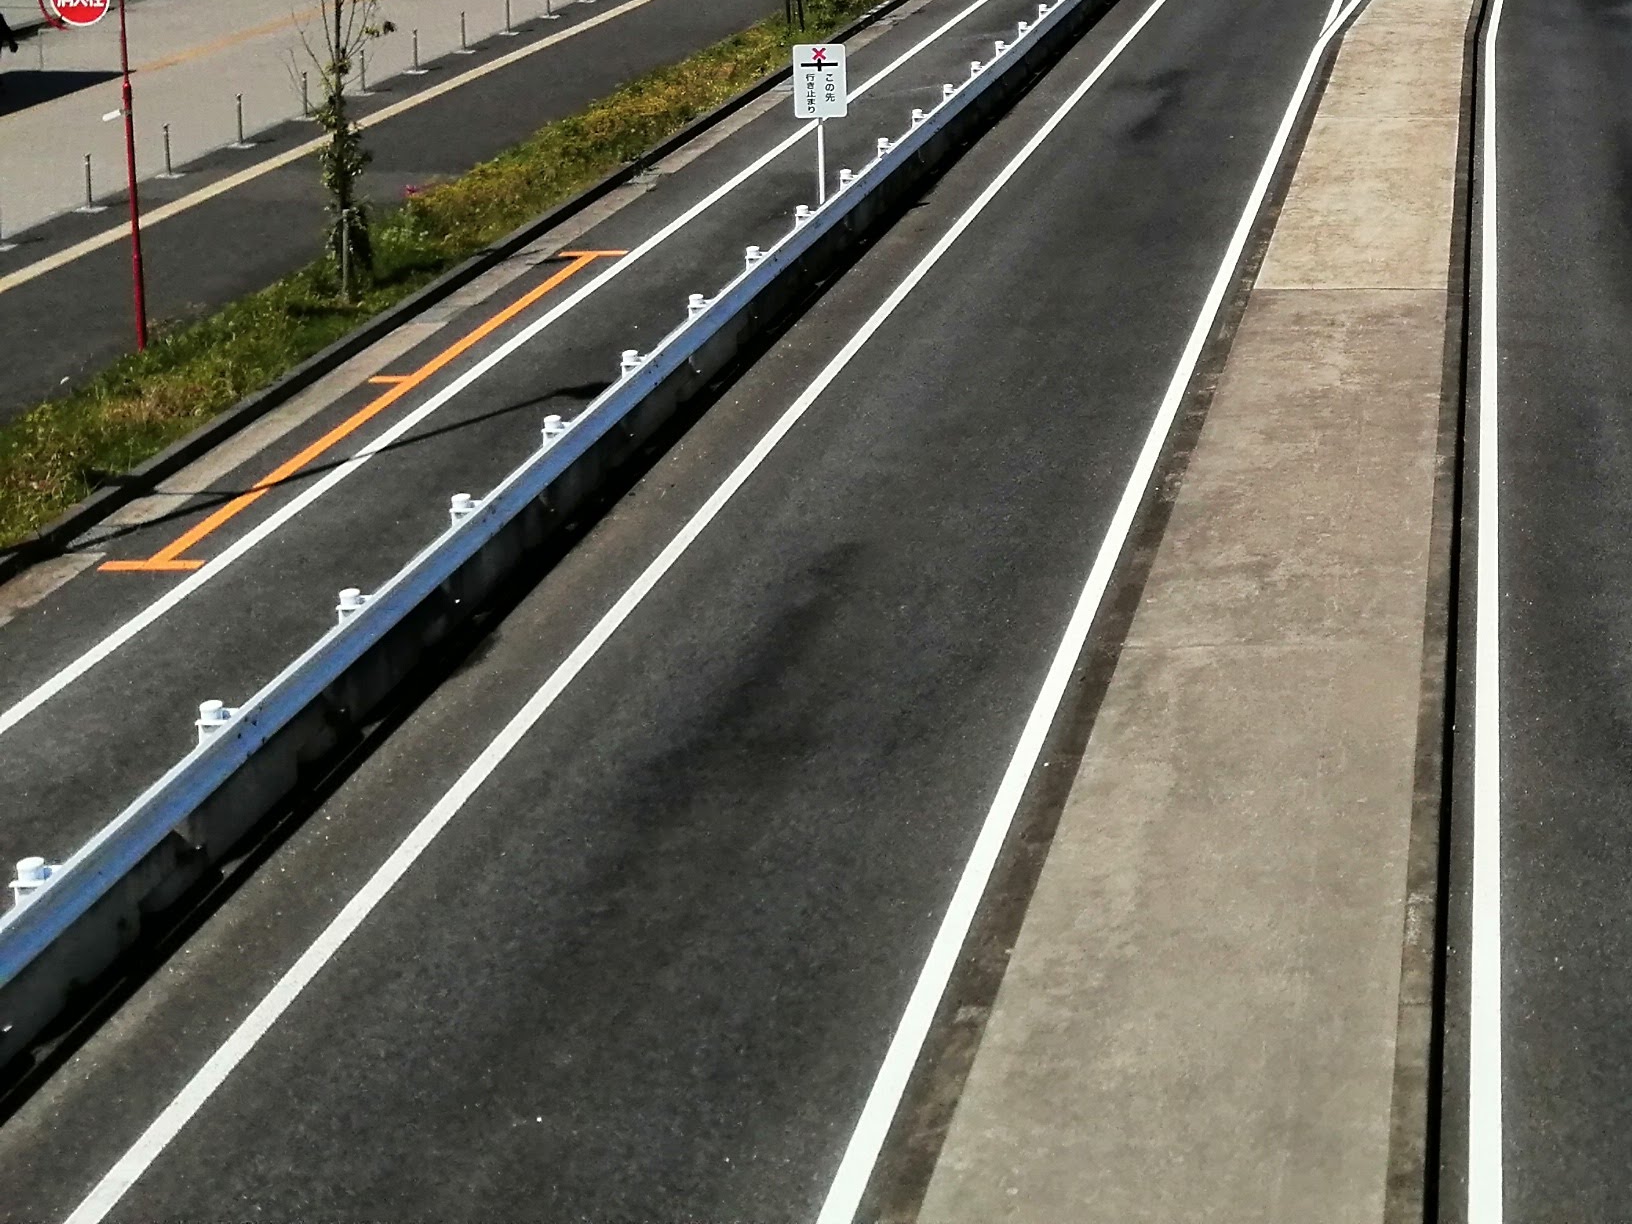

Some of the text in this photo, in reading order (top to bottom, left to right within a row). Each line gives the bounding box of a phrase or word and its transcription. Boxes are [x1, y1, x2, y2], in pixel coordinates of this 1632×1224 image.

[805, 73, 816, 113] 行き止まり
[825, 73, 835, 102] この先
